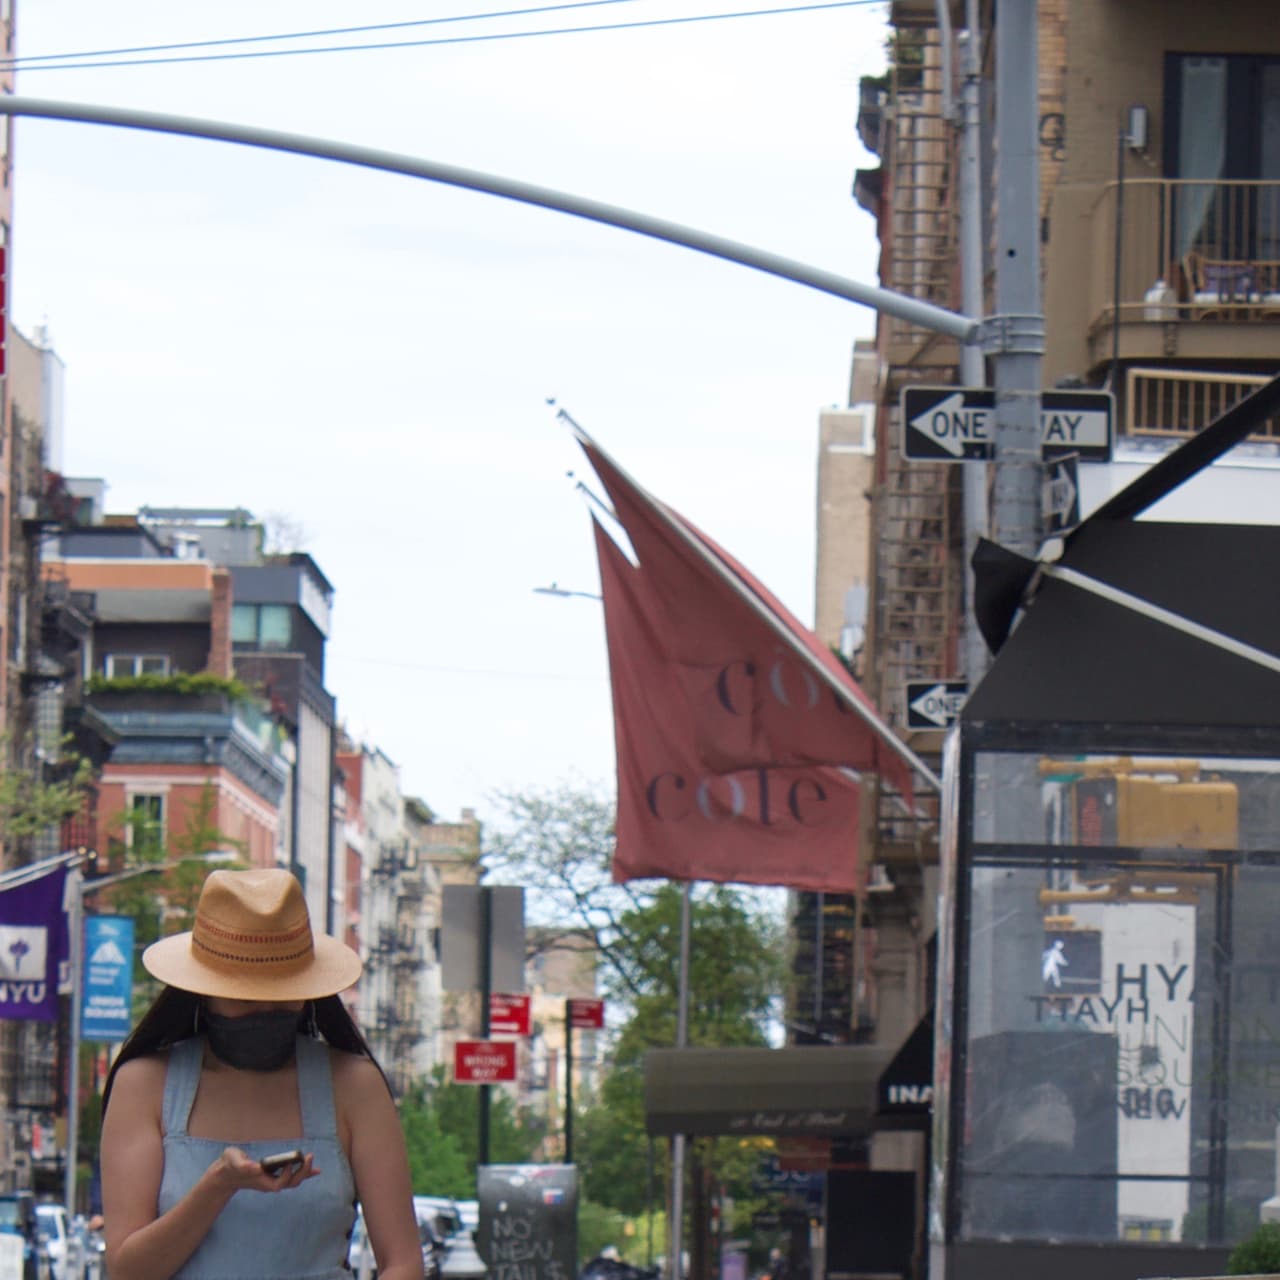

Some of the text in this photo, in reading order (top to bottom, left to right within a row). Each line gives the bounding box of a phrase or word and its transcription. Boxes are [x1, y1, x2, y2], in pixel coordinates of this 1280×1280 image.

[931, 410, 1083, 442] ONE AY
[923, 695, 962, 715] ONE
[492, 1216, 532, 1240] NO
[490, 1239, 554, 1262] NEW
